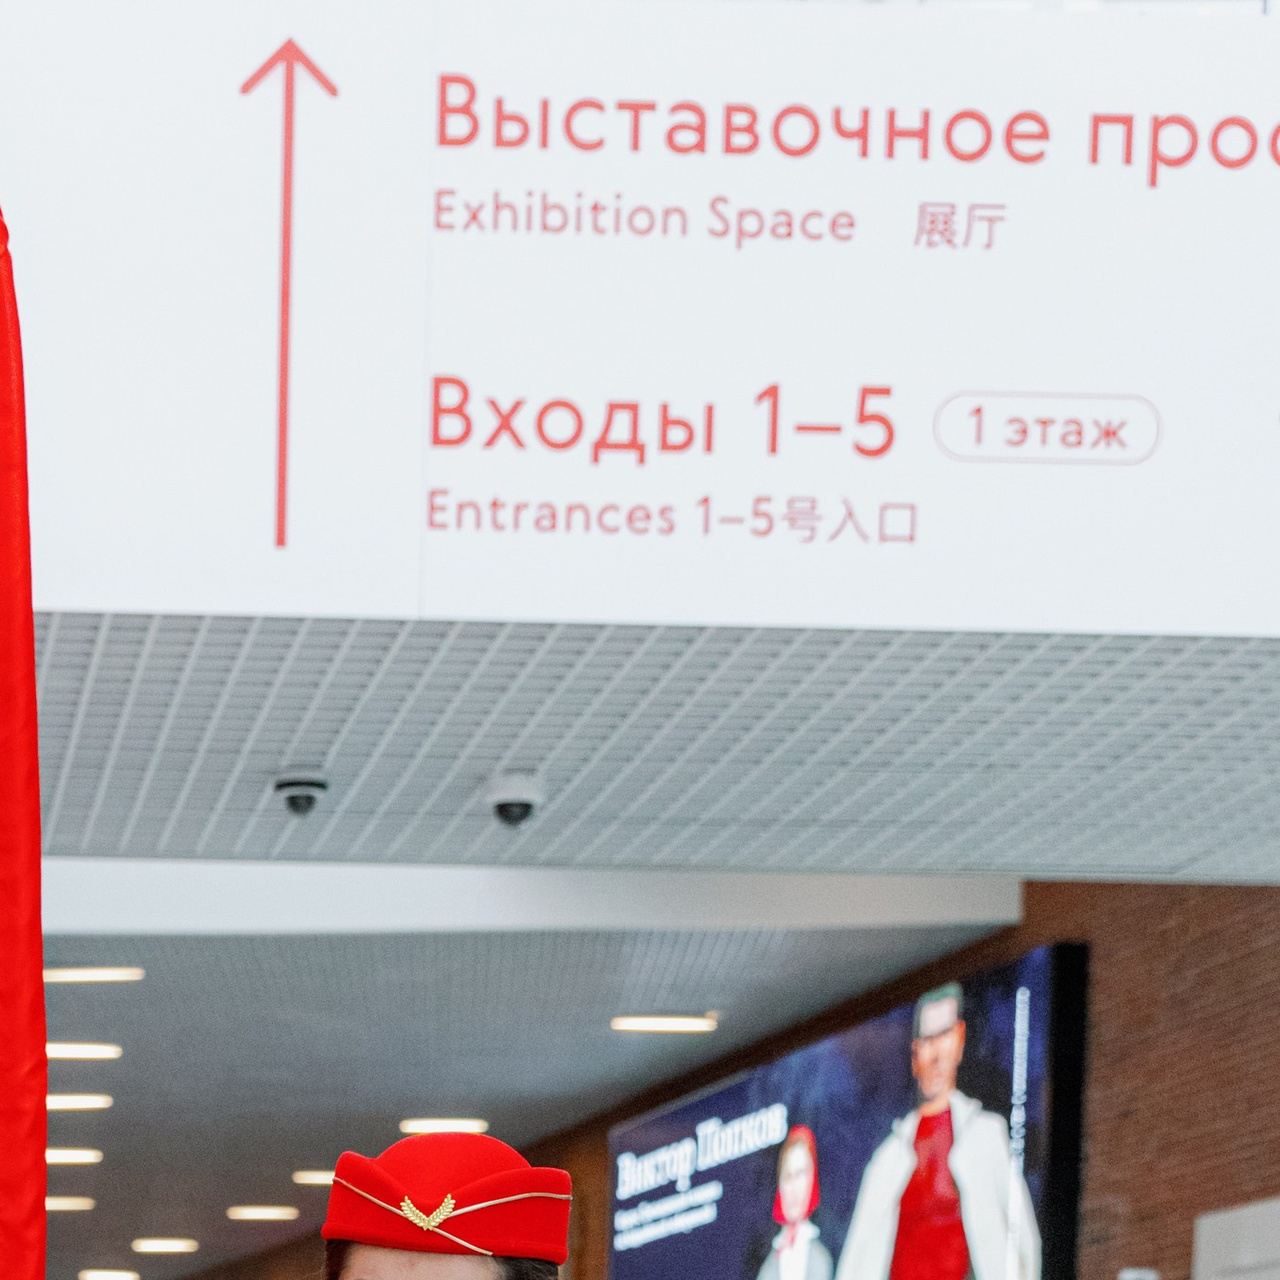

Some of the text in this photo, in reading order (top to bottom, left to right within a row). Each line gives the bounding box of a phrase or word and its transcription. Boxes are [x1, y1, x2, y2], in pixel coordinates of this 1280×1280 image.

[435, 73, 1280, 190] Выставочное про
[433, 189, 858, 250] Exhibition Space
[913, 201, 1005, 250] 展厅
[429, 374, 896, 466] Входы 1–5
[968, 405, 1128, 451] 1 этаж
[425, 488, 676, 536] Entrances
